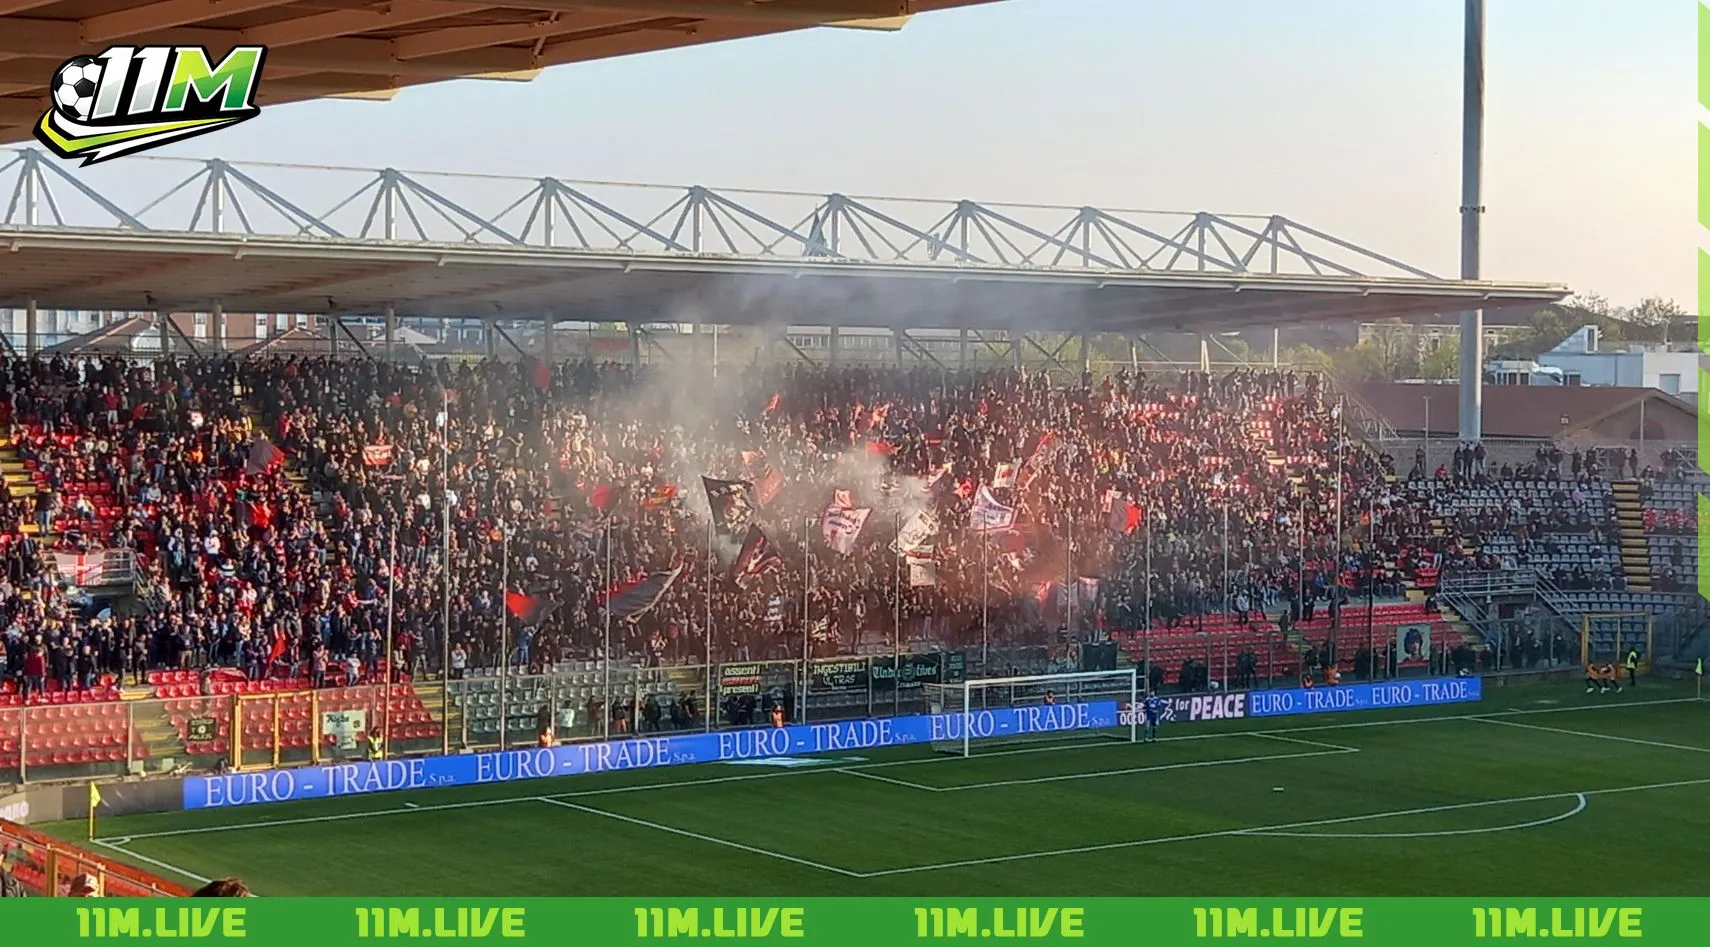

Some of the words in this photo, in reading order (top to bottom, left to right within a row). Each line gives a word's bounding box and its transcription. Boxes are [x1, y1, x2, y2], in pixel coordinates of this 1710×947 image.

[1175, 698, 1190, 711] for
[1190, 693, 1245, 720] PEACE
[1252, 692, 1293, 713] EURO
[1304, 689, 1355, 709] TRADE
[1372, 685, 1412, 705] EURO
[1423, 681, 1468, 701] TRADE
[719, 728, 789, 759] EURO
[810, 719, 893, 751] TRADE
[931, 711, 995, 740] EURO
[1013, 703, 1090, 733] TRADE
[475, 748, 555, 783] EURO
[578, 737, 671, 772] TRADE
[204, 770, 294, 807] EURO
[322, 758, 426, 796] TRADE
